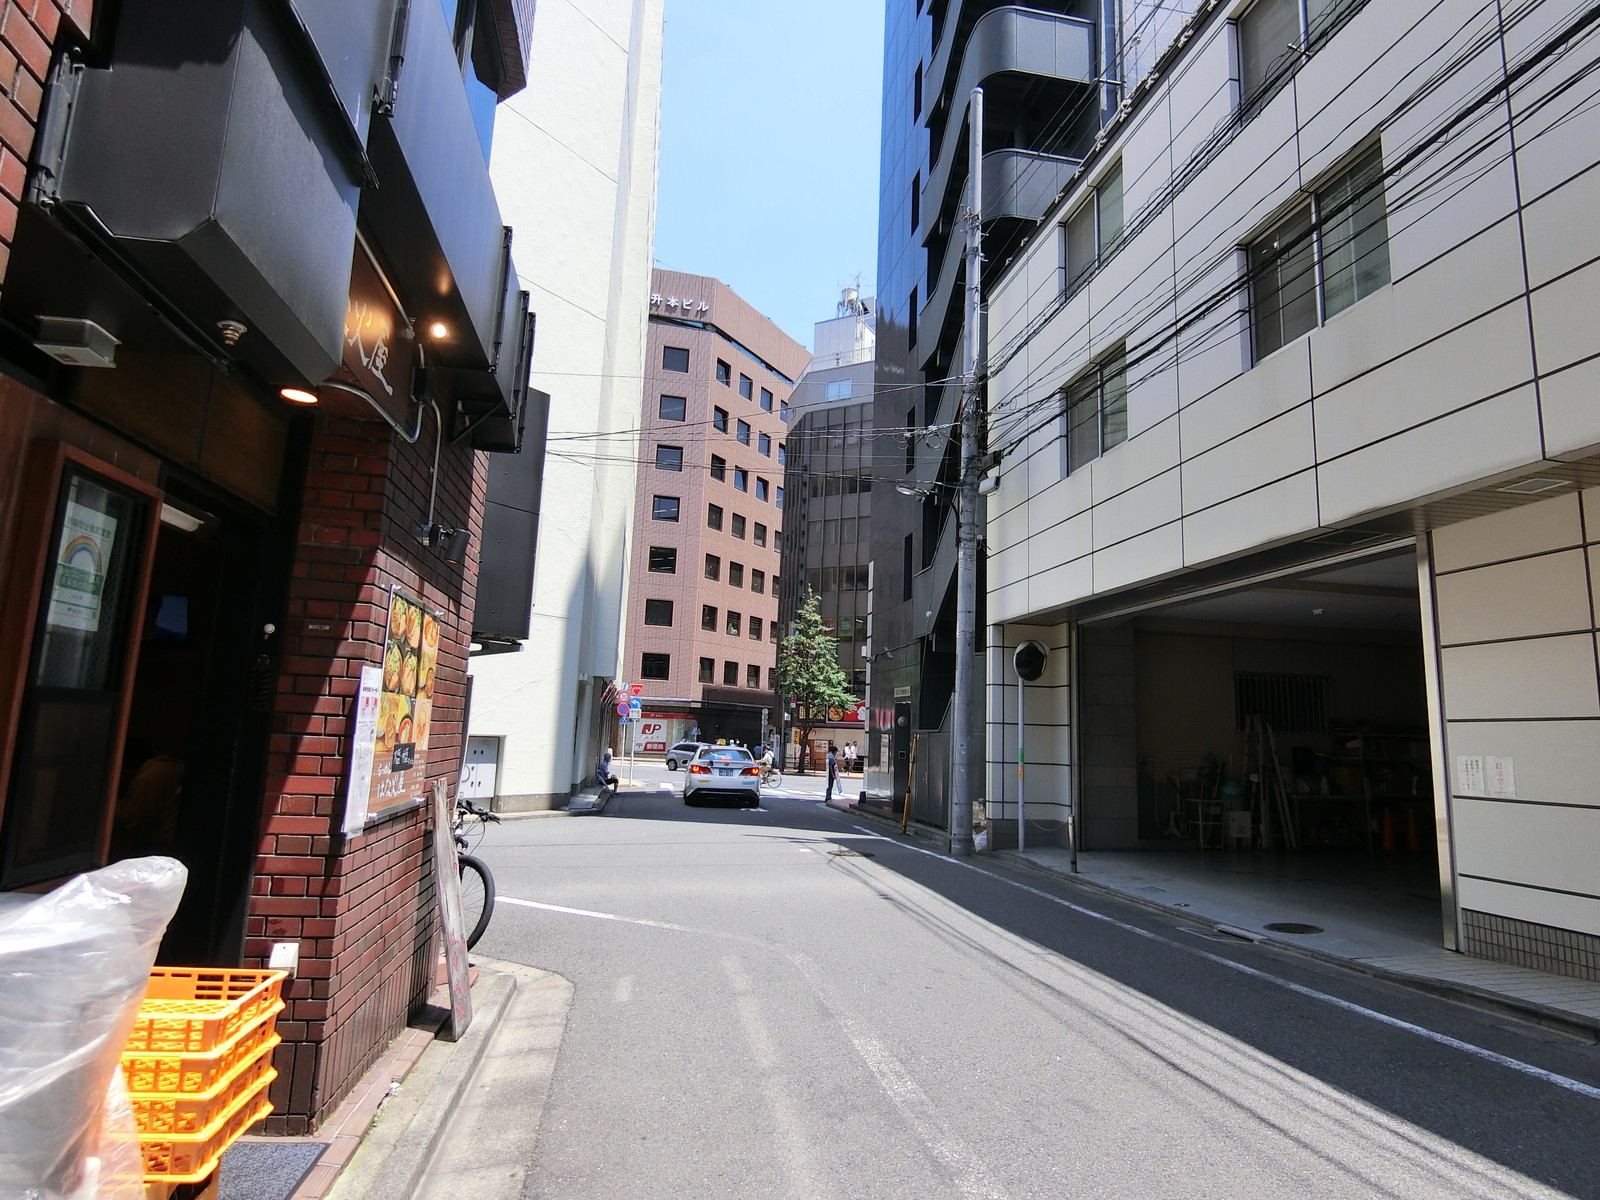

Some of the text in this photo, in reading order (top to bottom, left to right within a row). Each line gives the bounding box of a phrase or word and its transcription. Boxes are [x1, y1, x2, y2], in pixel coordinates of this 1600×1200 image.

[650, 294, 709, 311] 升本ビル
[641, 724, 662, 734] JP
